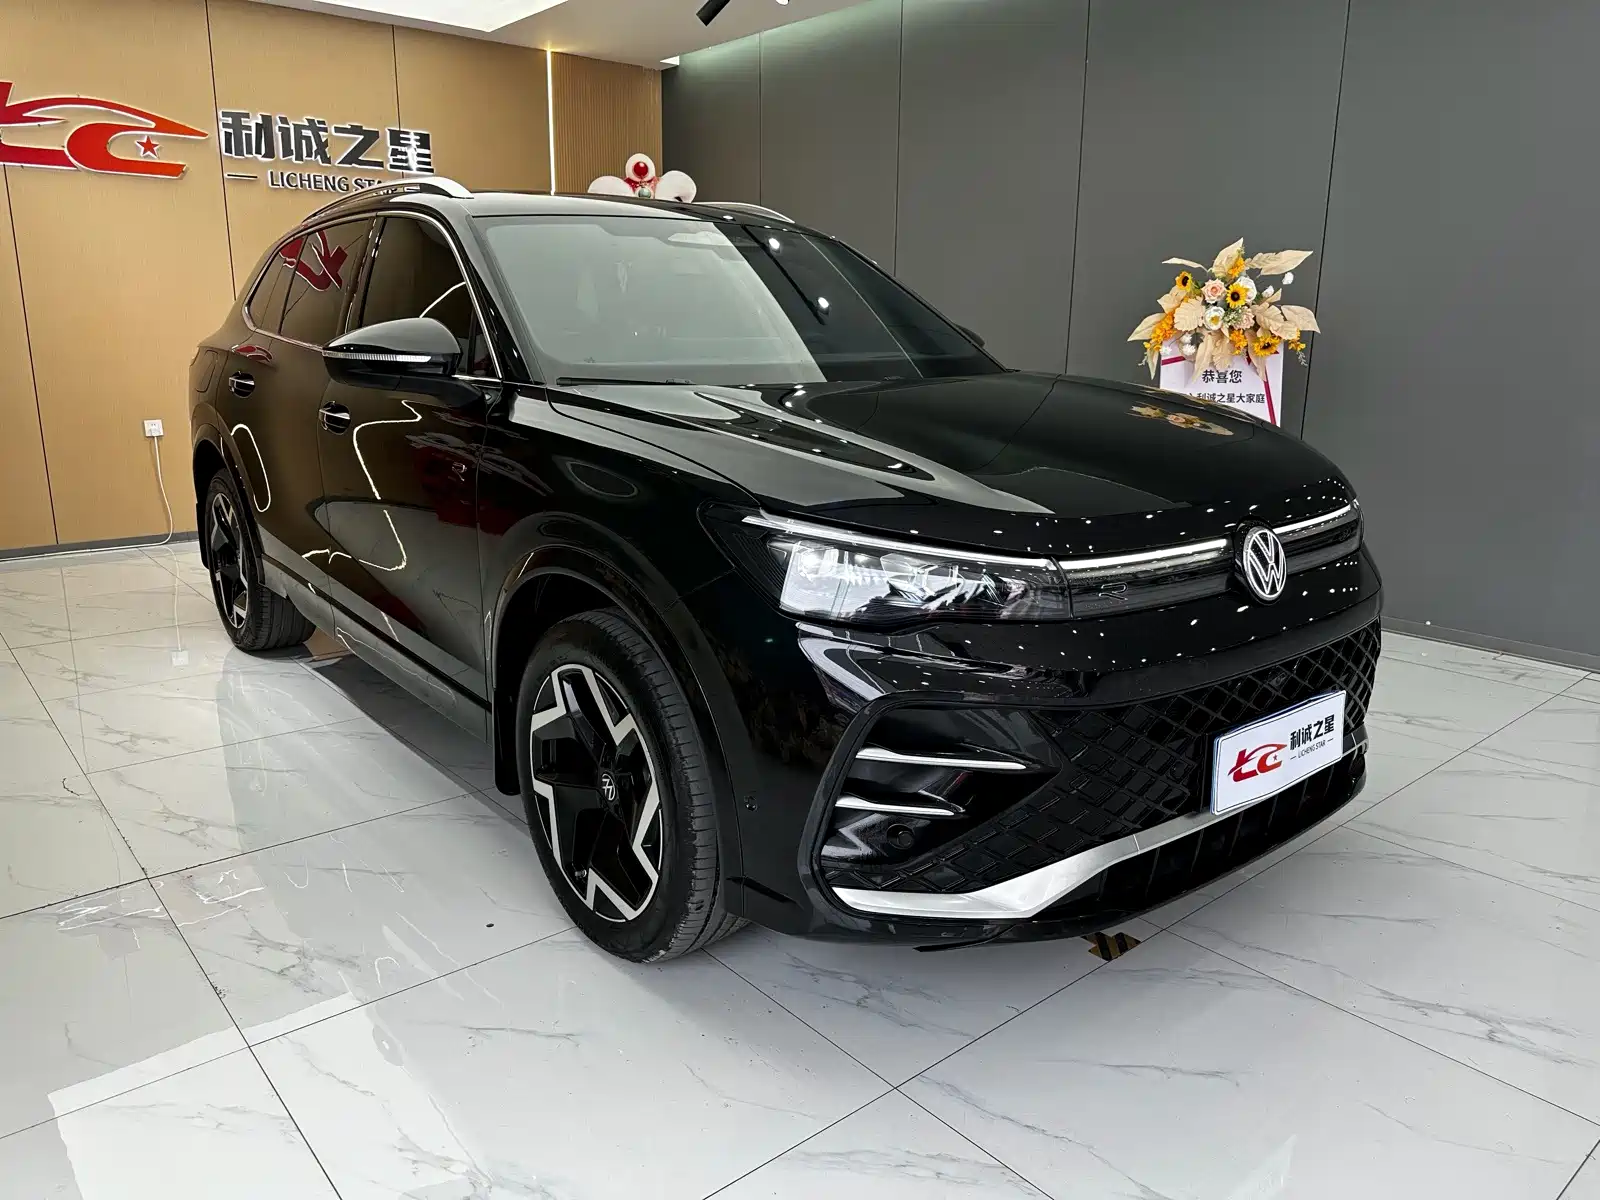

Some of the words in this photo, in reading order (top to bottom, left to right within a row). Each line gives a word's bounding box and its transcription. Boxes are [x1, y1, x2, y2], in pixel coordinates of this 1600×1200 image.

[221, 110, 435, 174] 利诚之星
[269, 170, 350, 192] LICHENG
[353, 177, 383, 192] ST
[1202, 369, 1243, 384] 恭喜您
[1189, 392, 1266, 404] 利诚之星大家庭
[1289, 714, 1335, 751] 利诚之星
